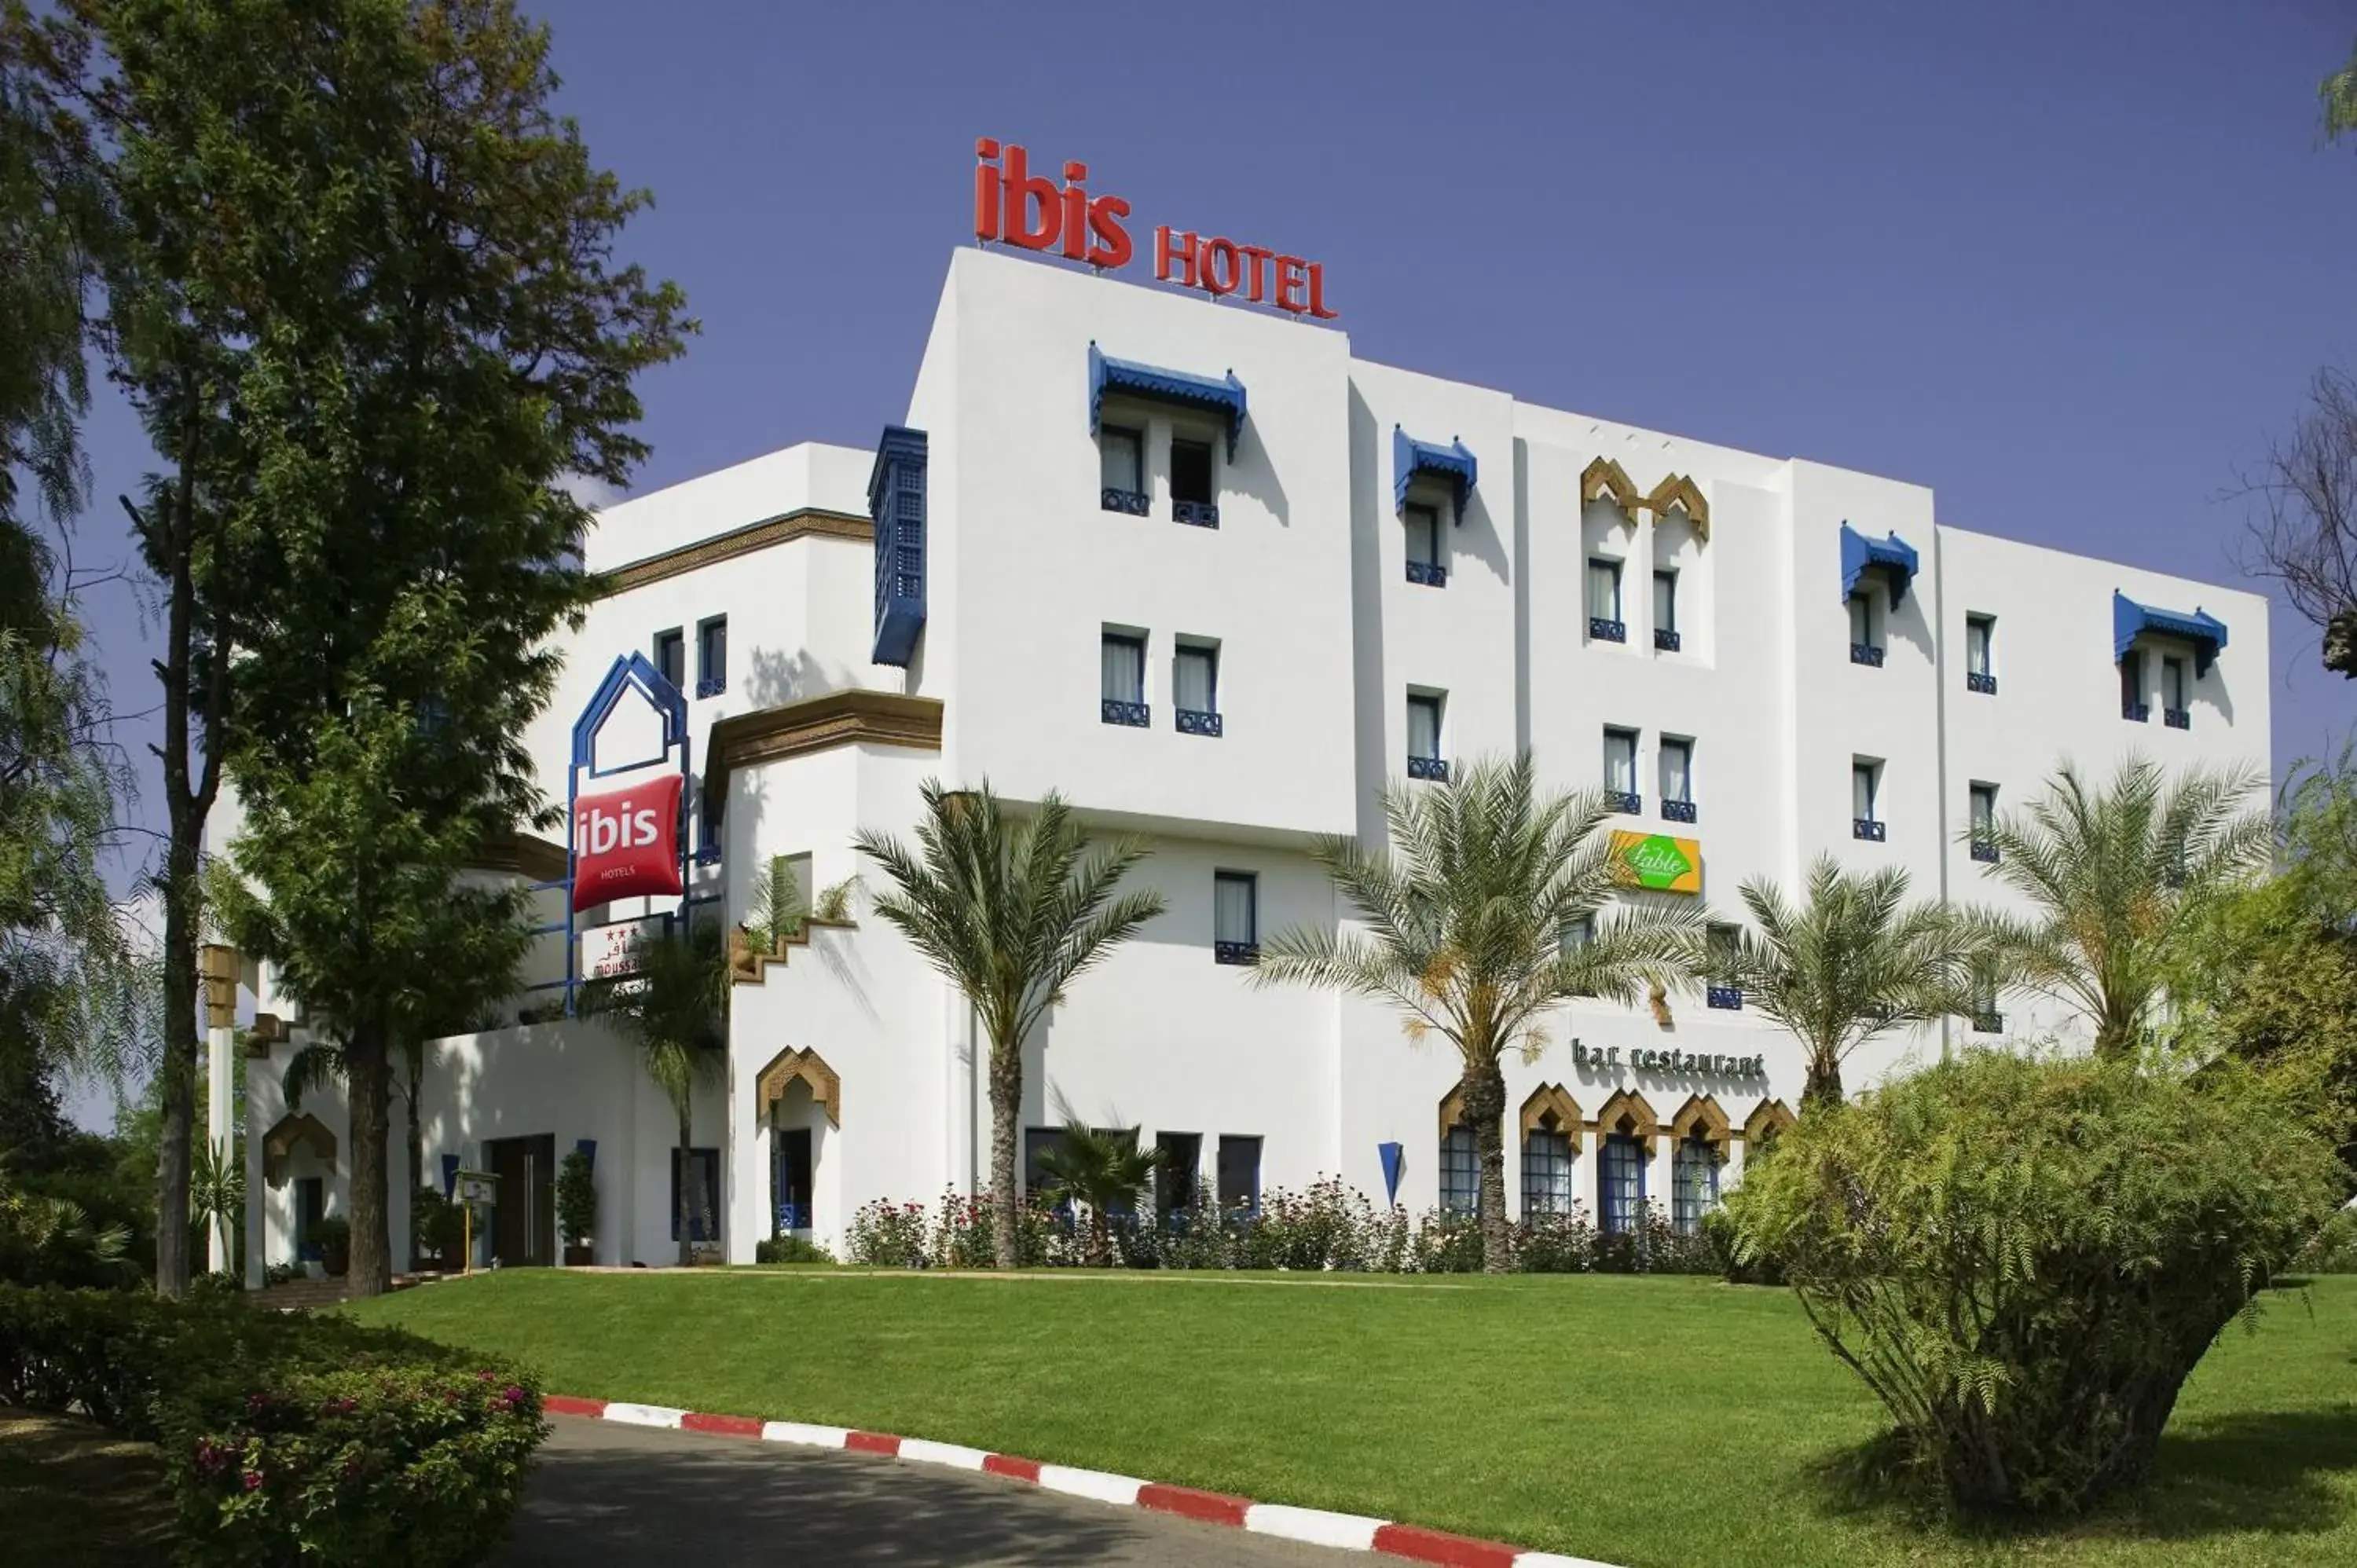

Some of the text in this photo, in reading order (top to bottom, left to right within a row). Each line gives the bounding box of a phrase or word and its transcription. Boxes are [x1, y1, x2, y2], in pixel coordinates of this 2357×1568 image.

[975, 137, 1338, 319] ibis HOTEL
[577, 800, 658, 858] ibis
[601, 865, 636, 880] HOTELS
[594, 954, 643, 976] moussa
[1572, 1038, 1767, 1079] bar restaurant
